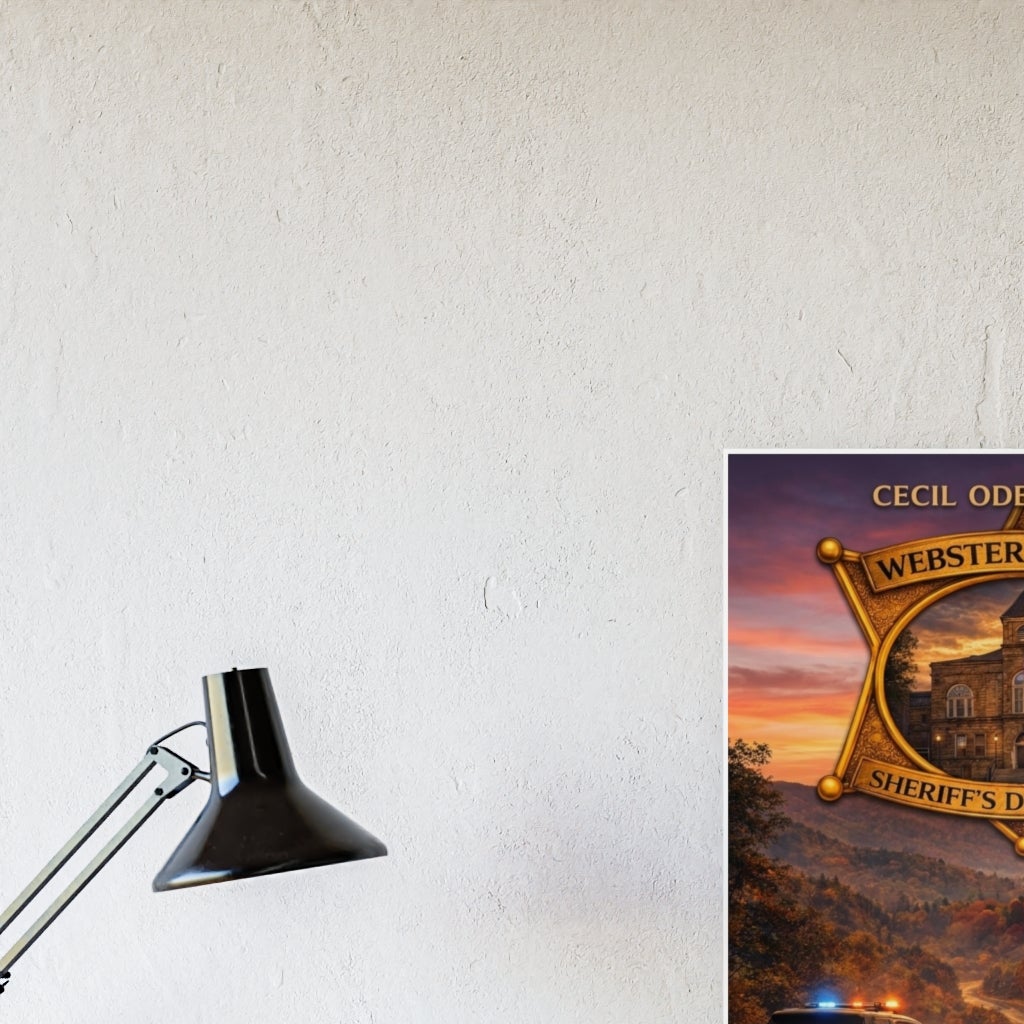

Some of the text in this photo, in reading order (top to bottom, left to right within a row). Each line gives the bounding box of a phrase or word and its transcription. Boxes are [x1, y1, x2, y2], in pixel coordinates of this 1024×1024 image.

[872, 484, 957, 507] CECIL
[876, 541, 1024, 580] WEBSTER
[869, 770, 996, 810] SHERIFF'S
